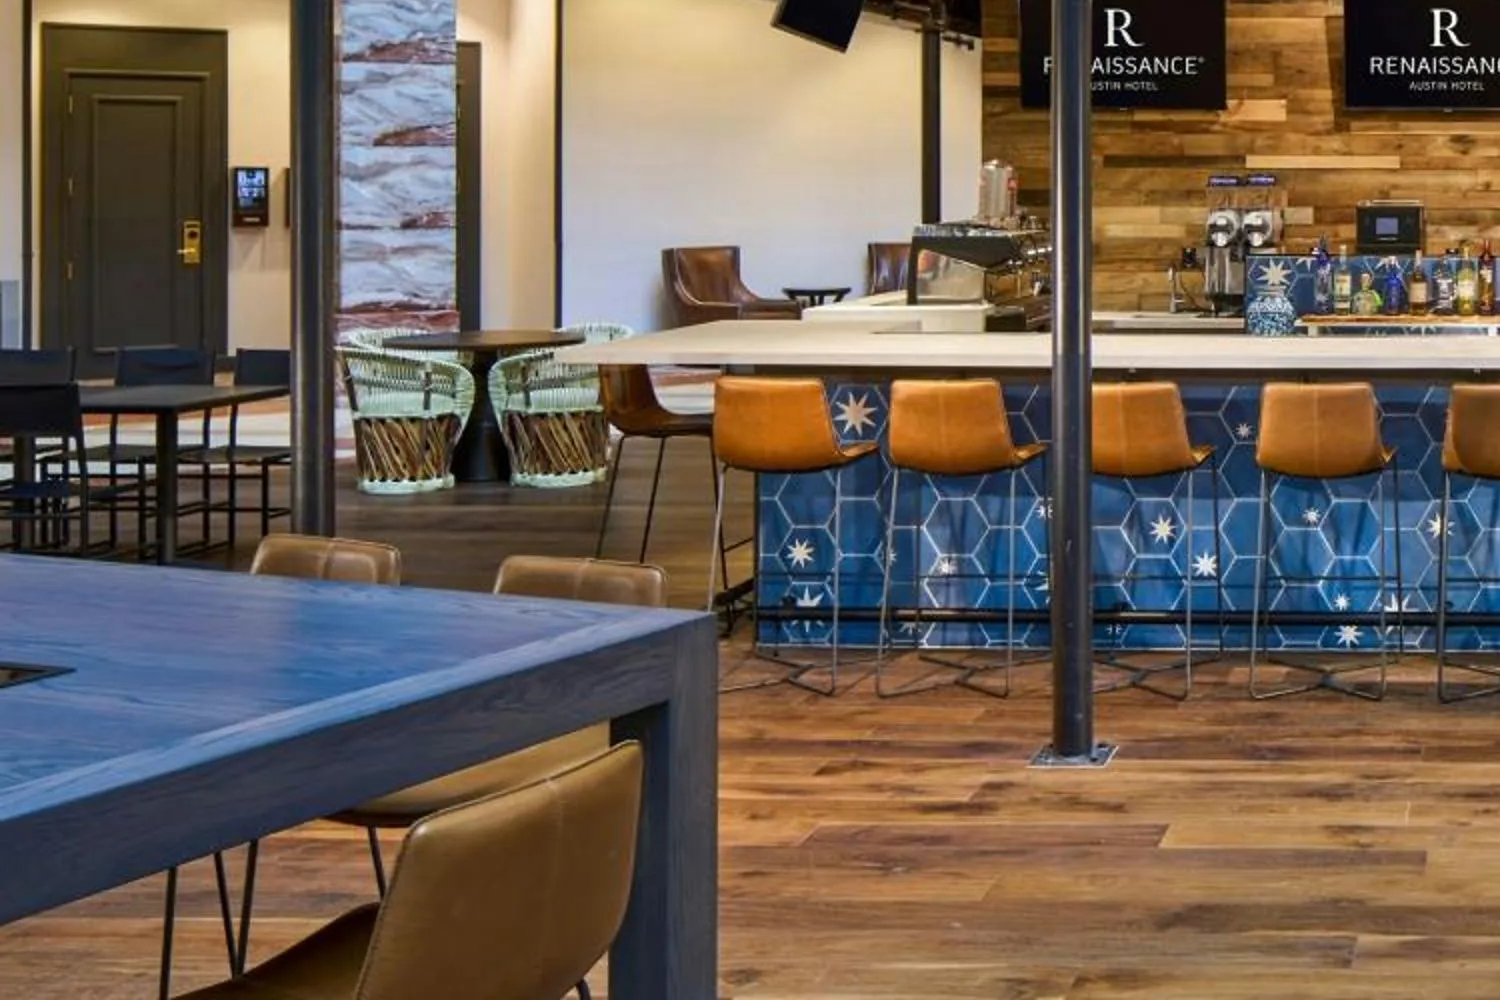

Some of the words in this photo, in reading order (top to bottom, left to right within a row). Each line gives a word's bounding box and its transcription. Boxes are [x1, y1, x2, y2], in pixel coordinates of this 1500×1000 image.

[1103, 7, 1146, 47] R
[1429, 7, 1471, 47] R
[1043, 56, 1199, 75] RAISSANCE
[1089, 81, 1121, 91] USTIN
[1124, 81, 1159, 92] HOTEL
[1409, 81, 1447, 92] AUSTIN
[1451, 81, 1485, 92] HOTEL
